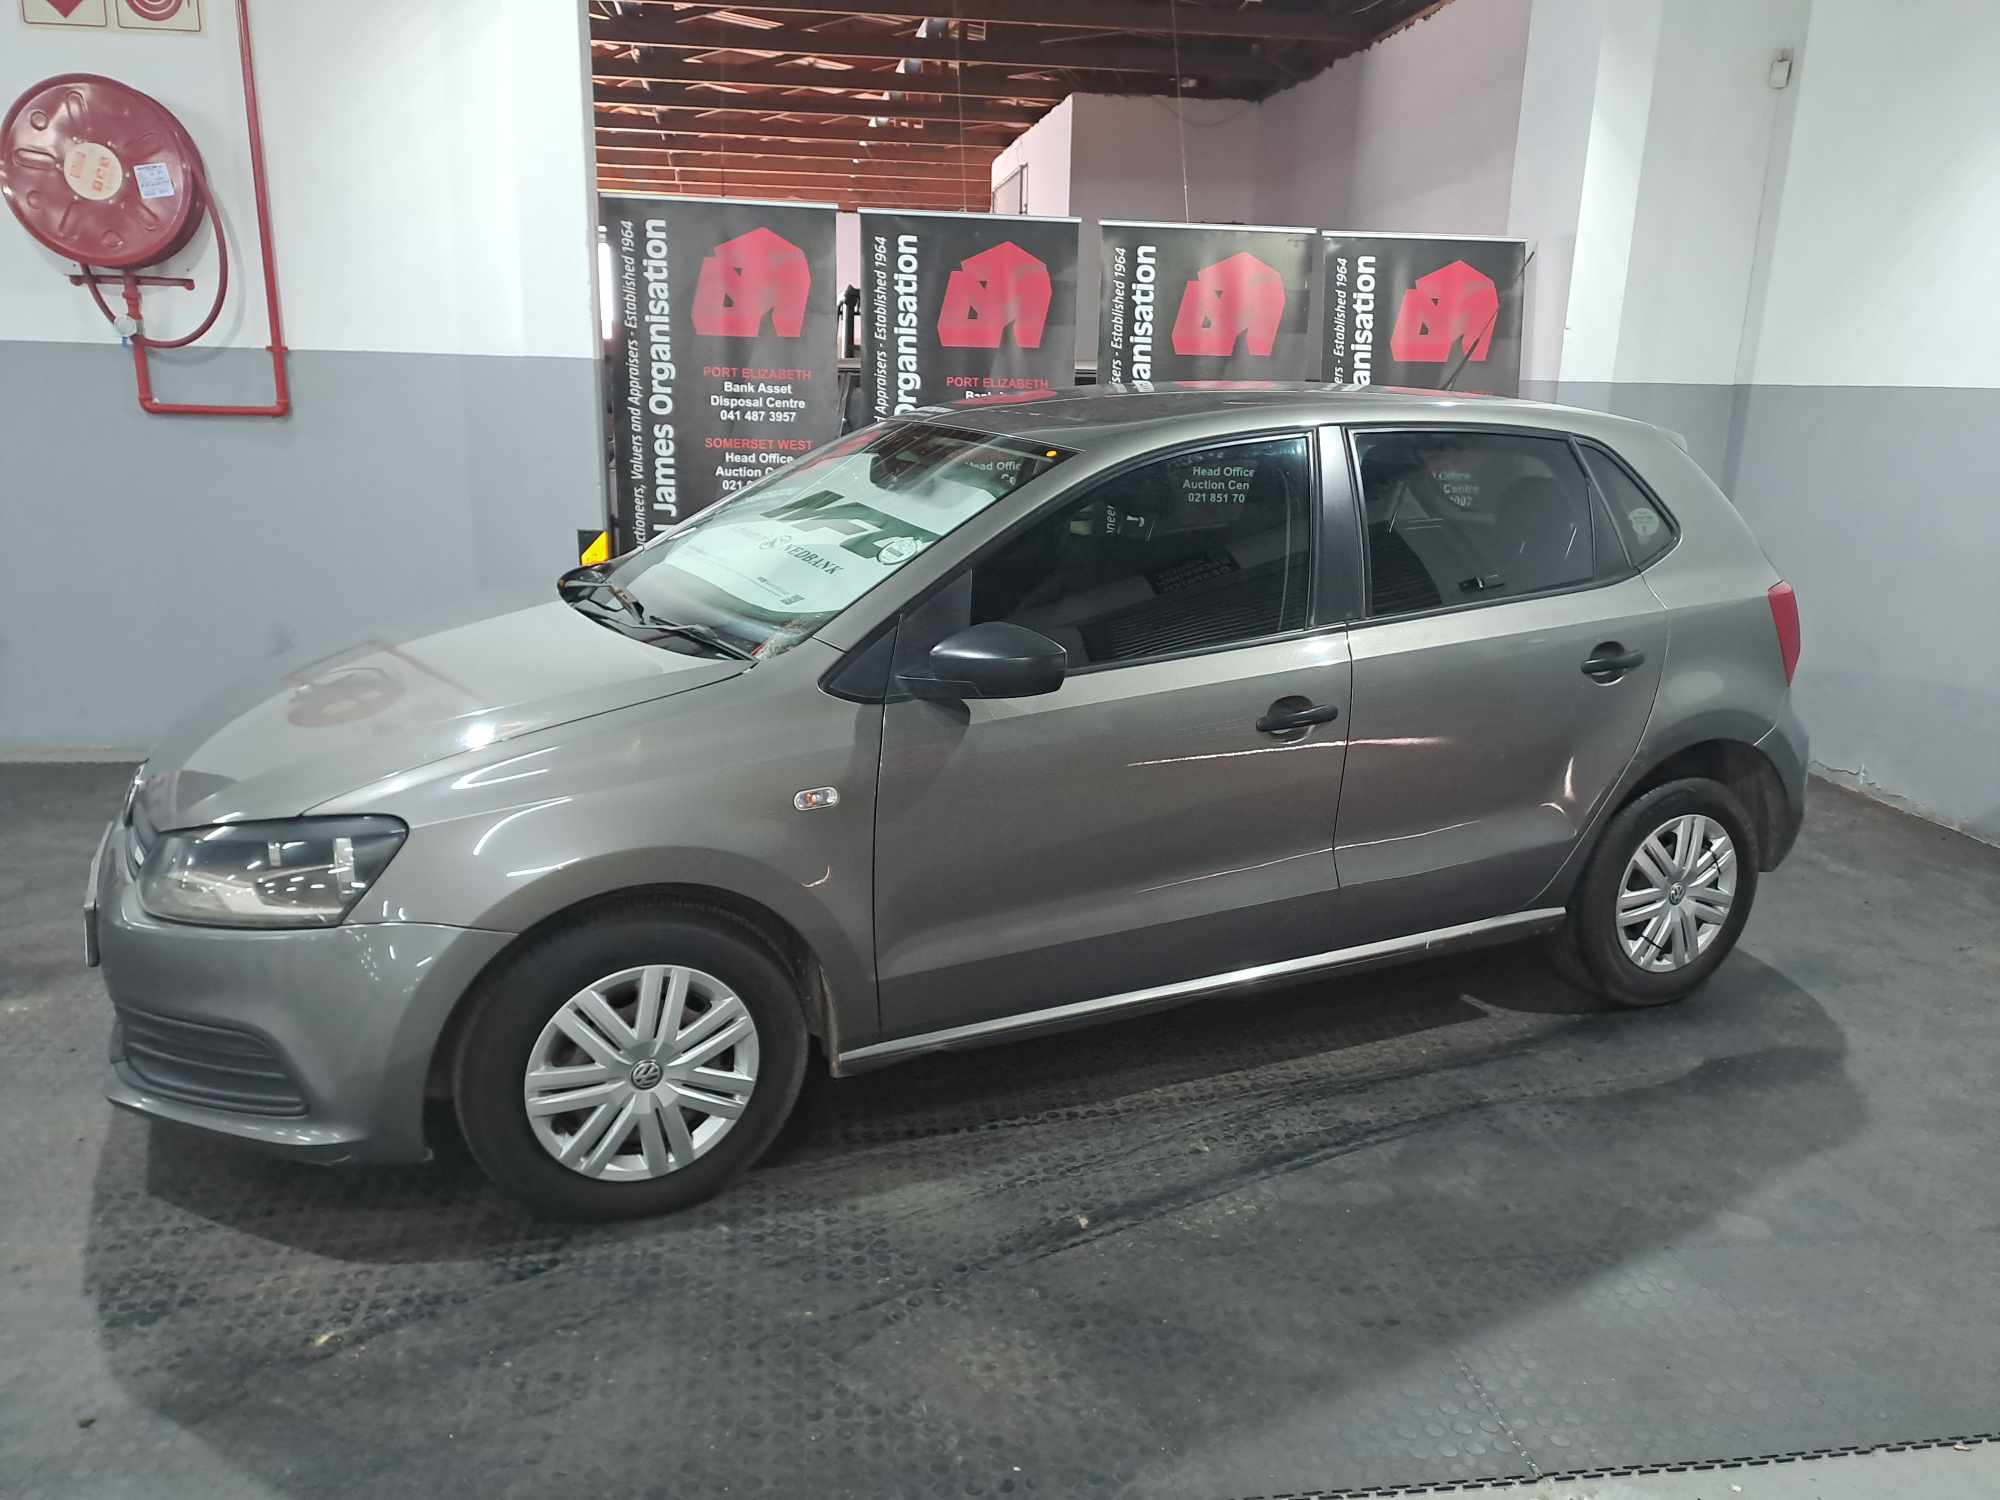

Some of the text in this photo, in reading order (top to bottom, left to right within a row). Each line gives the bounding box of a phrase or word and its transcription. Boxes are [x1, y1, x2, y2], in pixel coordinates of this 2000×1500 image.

[620, 220, 635, 252] 1964
[873, 235, 887, 267] 1964
[1114, 246, 1126, 277] 1964
[1336, 257, 1348, 287] 1964
[620, 254, 638, 328] Established
[873, 269, 887, 340] Established
[642, 218, 677, 416] Organisation
[1110, 279, 1126, 349] Established
[1333, 287, 1347, 357] Established
[625, 339, 643, 405] Appraisers
[703, 366, 812, 380] PORT ELIZABETH
[873, 350, 889, 415] Appraisers
[945, 376, 1049, 389] PORT ELIZABETH
[723, 381, 793, 394] Bank Asset
[710, 395, 806, 409] Disposal Centre
[720, 409, 797, 422] 041 487 3957
[627, 407, 642, 432] and
[629, 434, 644, 479] Valuers
[704, 437, 813, 450] SOMERSET WEST
[652, 423, 677, 517] James
[715, 466, 762, 477] Auction
[724, 452, 794, 464] Head Office
[1192, 466, 1220, 477] Head
[722, 479, 742, 490] 021
[1182, 479, 1225, 490] Auction
[1188, 492, 1246, 503] 021 851 70
